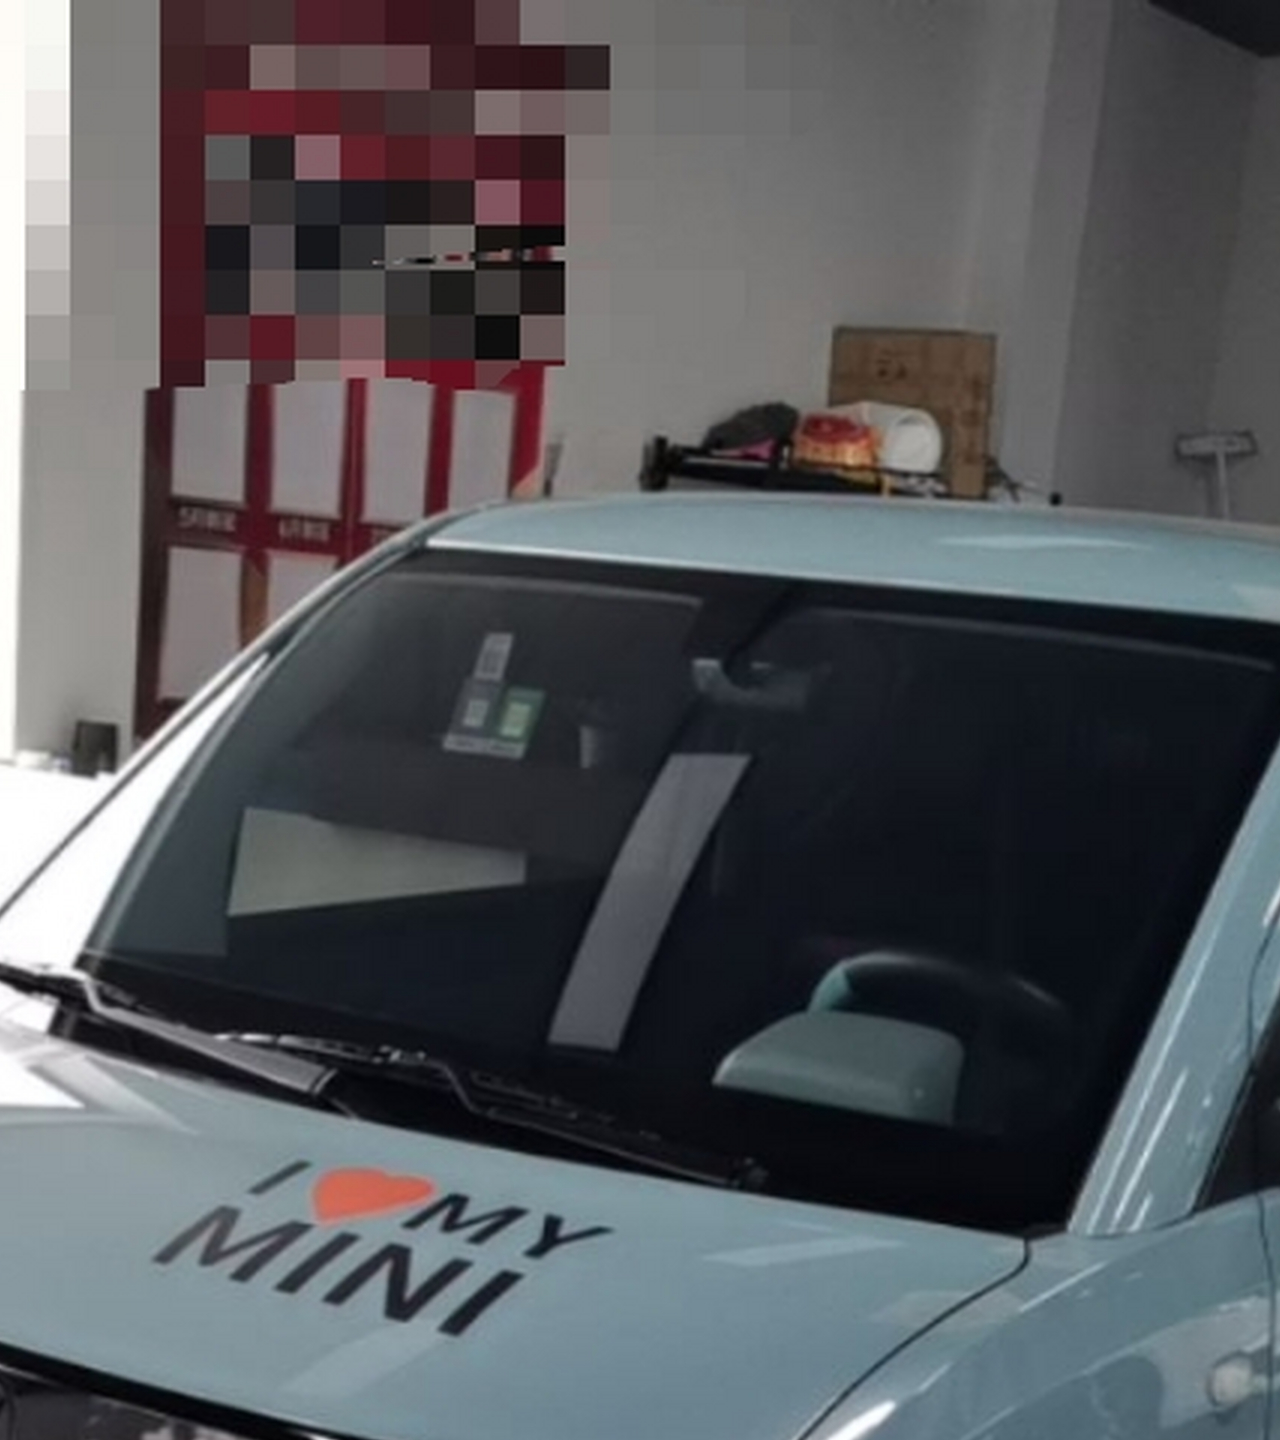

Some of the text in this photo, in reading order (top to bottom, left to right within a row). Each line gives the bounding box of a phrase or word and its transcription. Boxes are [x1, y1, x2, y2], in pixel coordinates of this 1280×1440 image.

[248, 1160, 615, 1260] I MY
[153, 1205, 524, 1338] MINI
